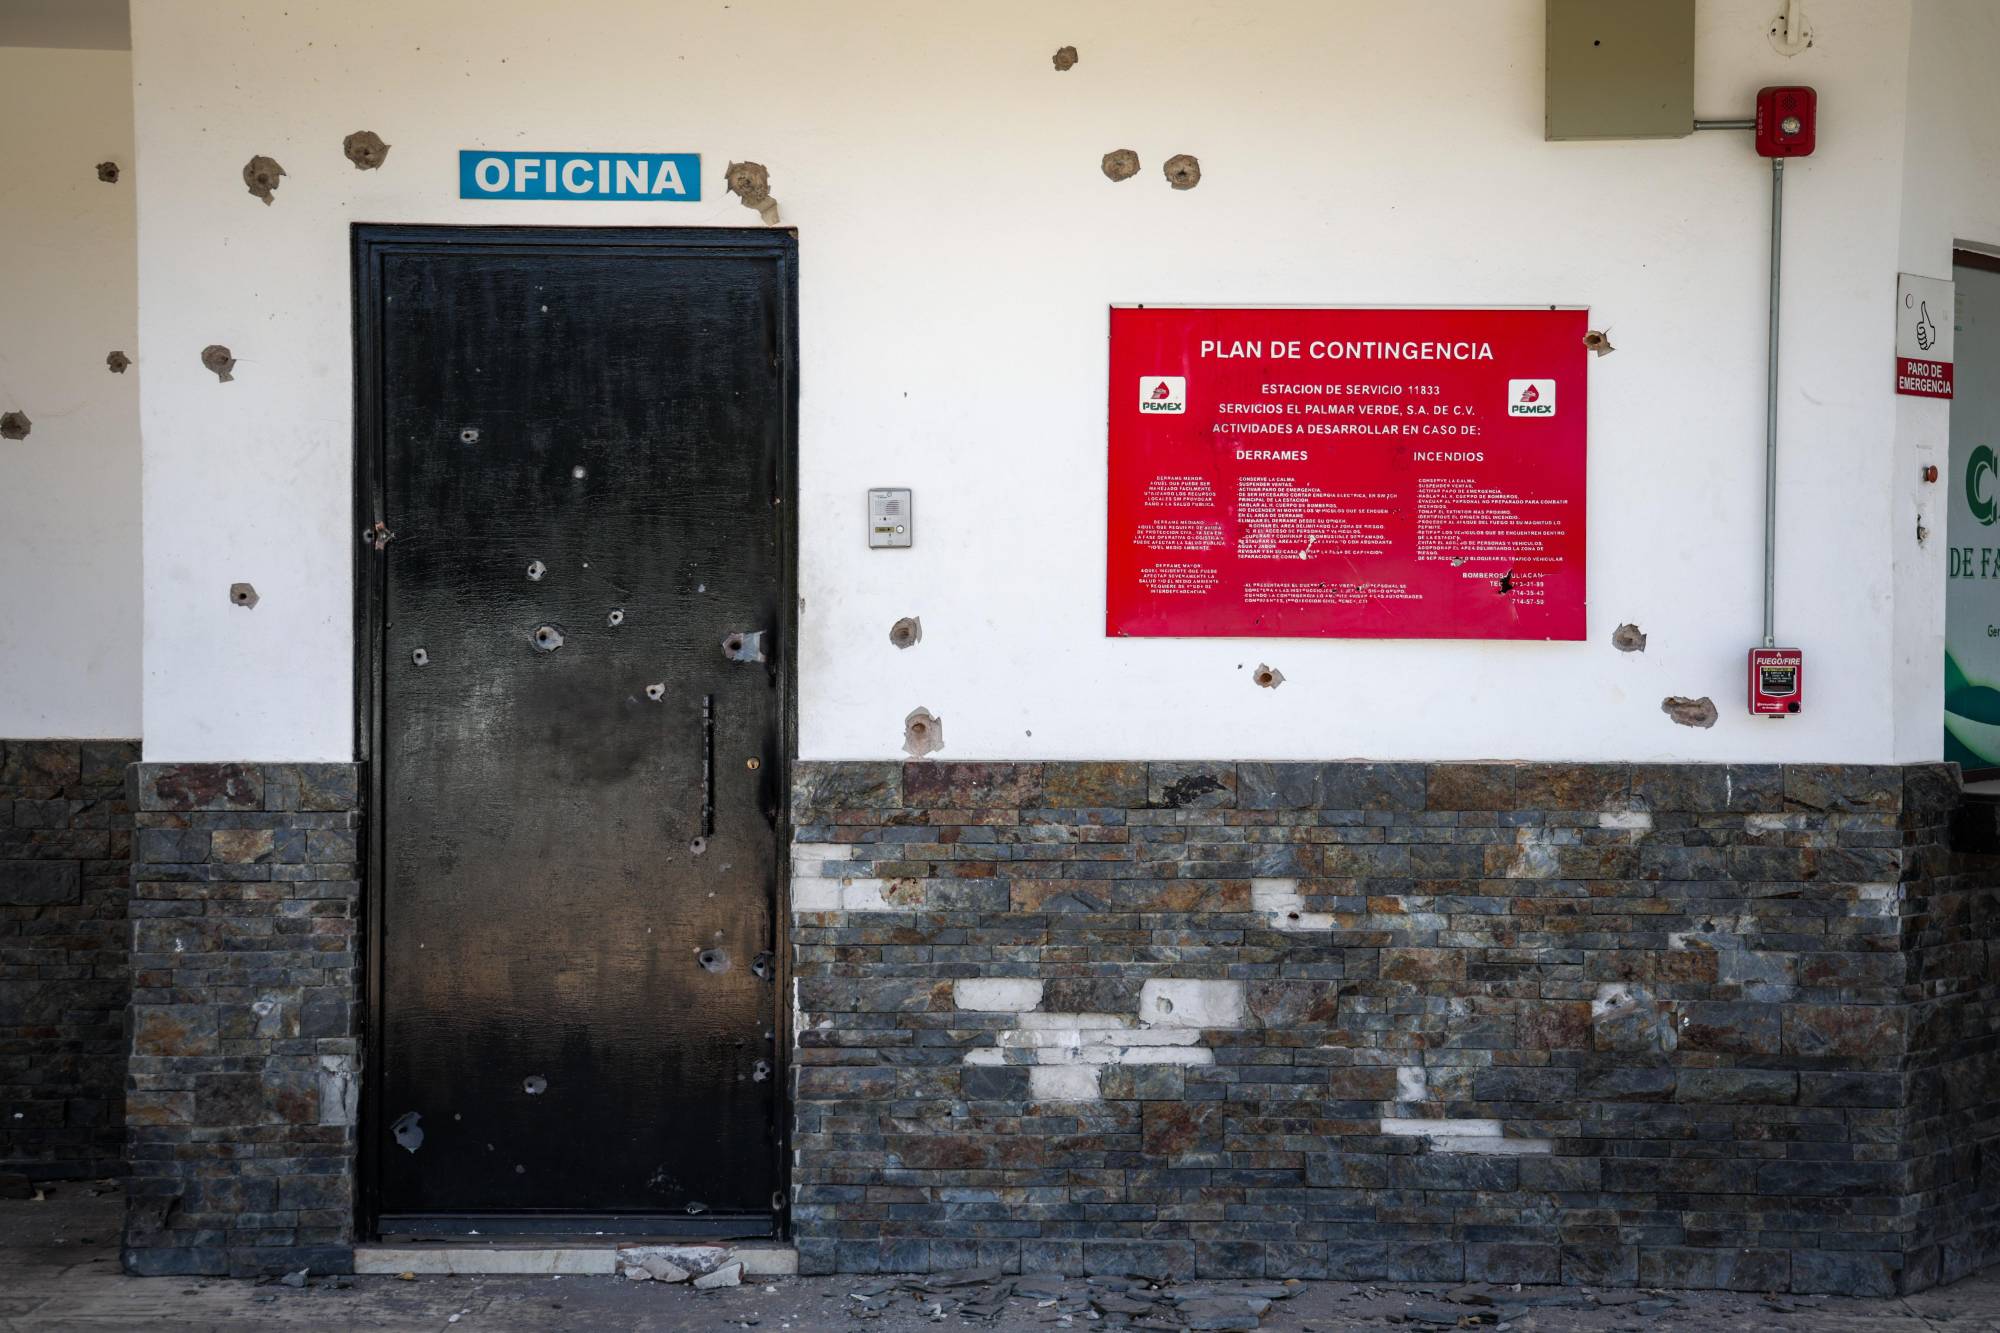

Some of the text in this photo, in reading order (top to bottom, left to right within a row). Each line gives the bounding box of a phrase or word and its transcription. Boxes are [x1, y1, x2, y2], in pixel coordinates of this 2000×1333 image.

[475, 157, 687, 195] OFICINA
[1201, 340, 1494, 361] PLAN DE CONTINGENCIA
[1907, 361, 1943, 379] PARO DE
[1262, 384, 1441, 396] ESTACION DE SERVICIO 11833
[1900, 375, 1952, 394] EMERGENCIA
[1143, 402, 1182, 411] PEMEX
[1219, 403, 1476, 417] SERVICIOS EL PALMAR VERDE, S.A. DE C.V.
[1512, 405, 1552, 414] PEMEX
[1212, 423, 1481, 436] ACTIVIDADES A DESARROLLAR EN CASO DE:
[1236, 450, 1308, 461] DERRAMES
[1414, 451, 1485, 462] INCENDIOS
[1966, 444, 2000, 527] C
[1950, 547, 1974, 578] DE
[1757, 657, 1801, 665] FUEGO/FIRE
